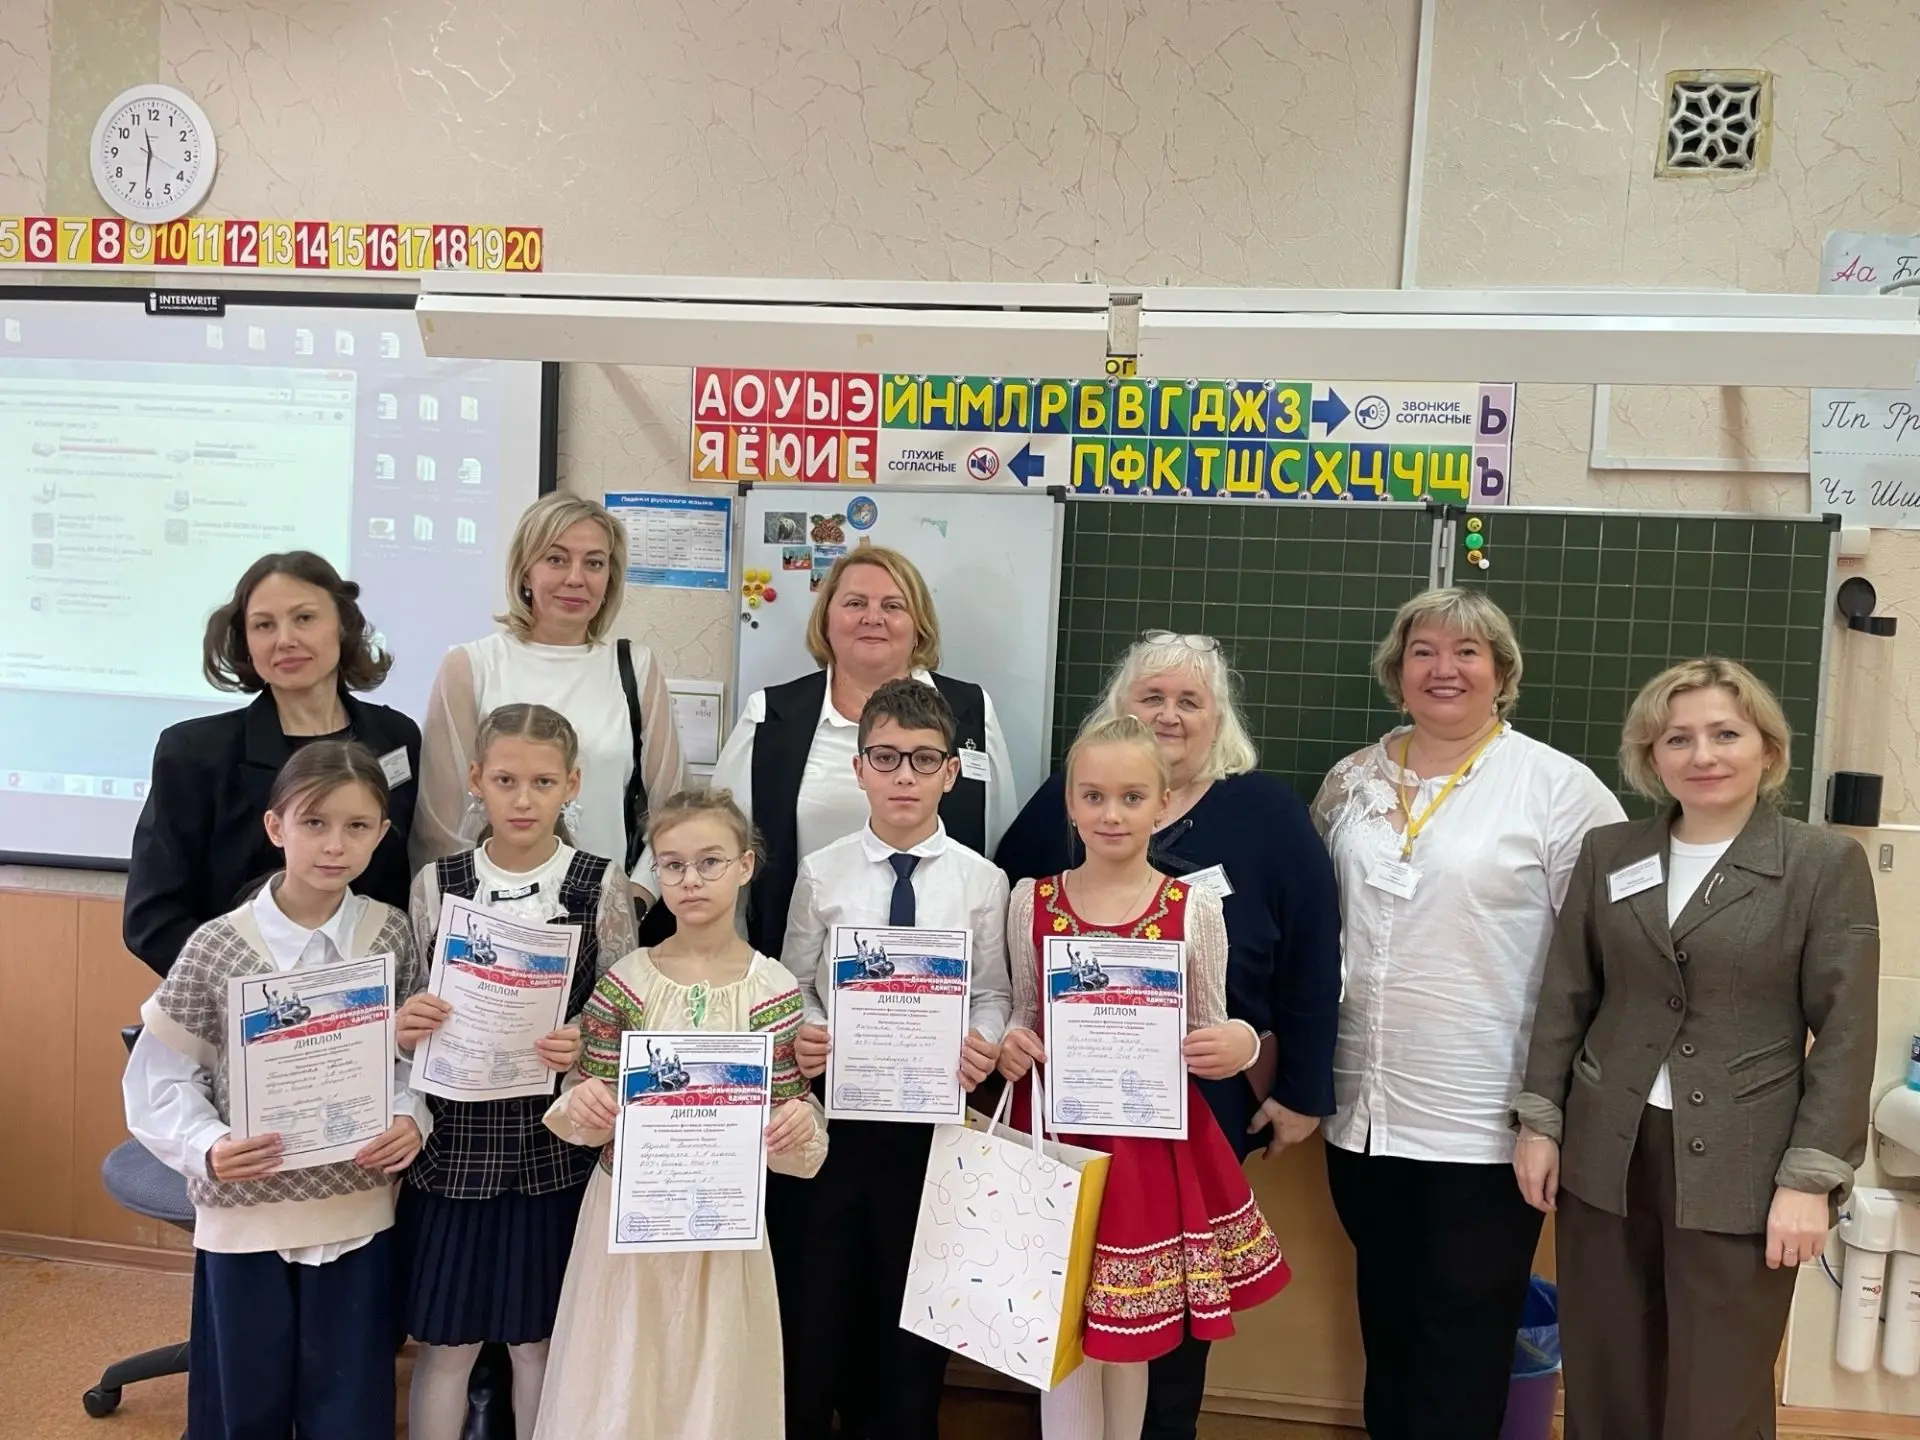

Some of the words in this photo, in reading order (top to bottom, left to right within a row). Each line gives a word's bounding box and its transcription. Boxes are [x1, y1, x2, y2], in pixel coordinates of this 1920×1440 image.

[131, 114, 140, 126] 11
[148, 109, 160, 121] 12
[168, 115, 174, 127] 1
[118, 127, 130, 139] 10
[179, 130, 187, 142] 2
[110, 147, 119, 158] 9
[183, 150, 192, 162] 3
[115, 167, 123, 178] 8
[176, 171, 184, 182] 4
[129, 182, 137, 193] 7
[145, 187, 153, 199] 6
[163, 183, 171, 195] 5
[0, 221, 20, 259] 5
[29, 221, 53, 259] 6
[63, 222, 89, 259] 7
[97, 221, 121, 259] 8
[128, 223, 152, 260] 9
[156, 223, 187, 260] 10
[192, 223, 220, 262] 11
[226, 224, 258, 263] 12
[262, 224, 293, 264] 13
[296, 225, 329, 266] 14
[331, 225, 365, 266] 15
[366, 227, 398, 267] 16
[399, 227, 433, 268] 17
[434, 228, 468, 268] 18
[470, 228, 505, 270] 19
[506, 230, 541, 271] 20
[1892, 255, 1920, 282] Б
[159, 295, 217, 306] INTERWRITE
[1401, 401, 1461, 413] ЗВОНКИЕ
[1395, 412, 1472, 425] СОГЛАСНЫЕ
[901, 448, 945, 462] ГЛУХИЕ
[888, 460, 957, 474] СОГЛАСНЫЕ
[478, 981, 520, 997] ДИПЛОМ
[878, 994, 921, 1004] ДИПЛОМ
[1093, 1006, 1137, 1017] ДИПЛОМ
[294, 1031, 343, 1050] ДИПЛОМ
[671, 1107, 718, 1119] ДИПЛОМ
